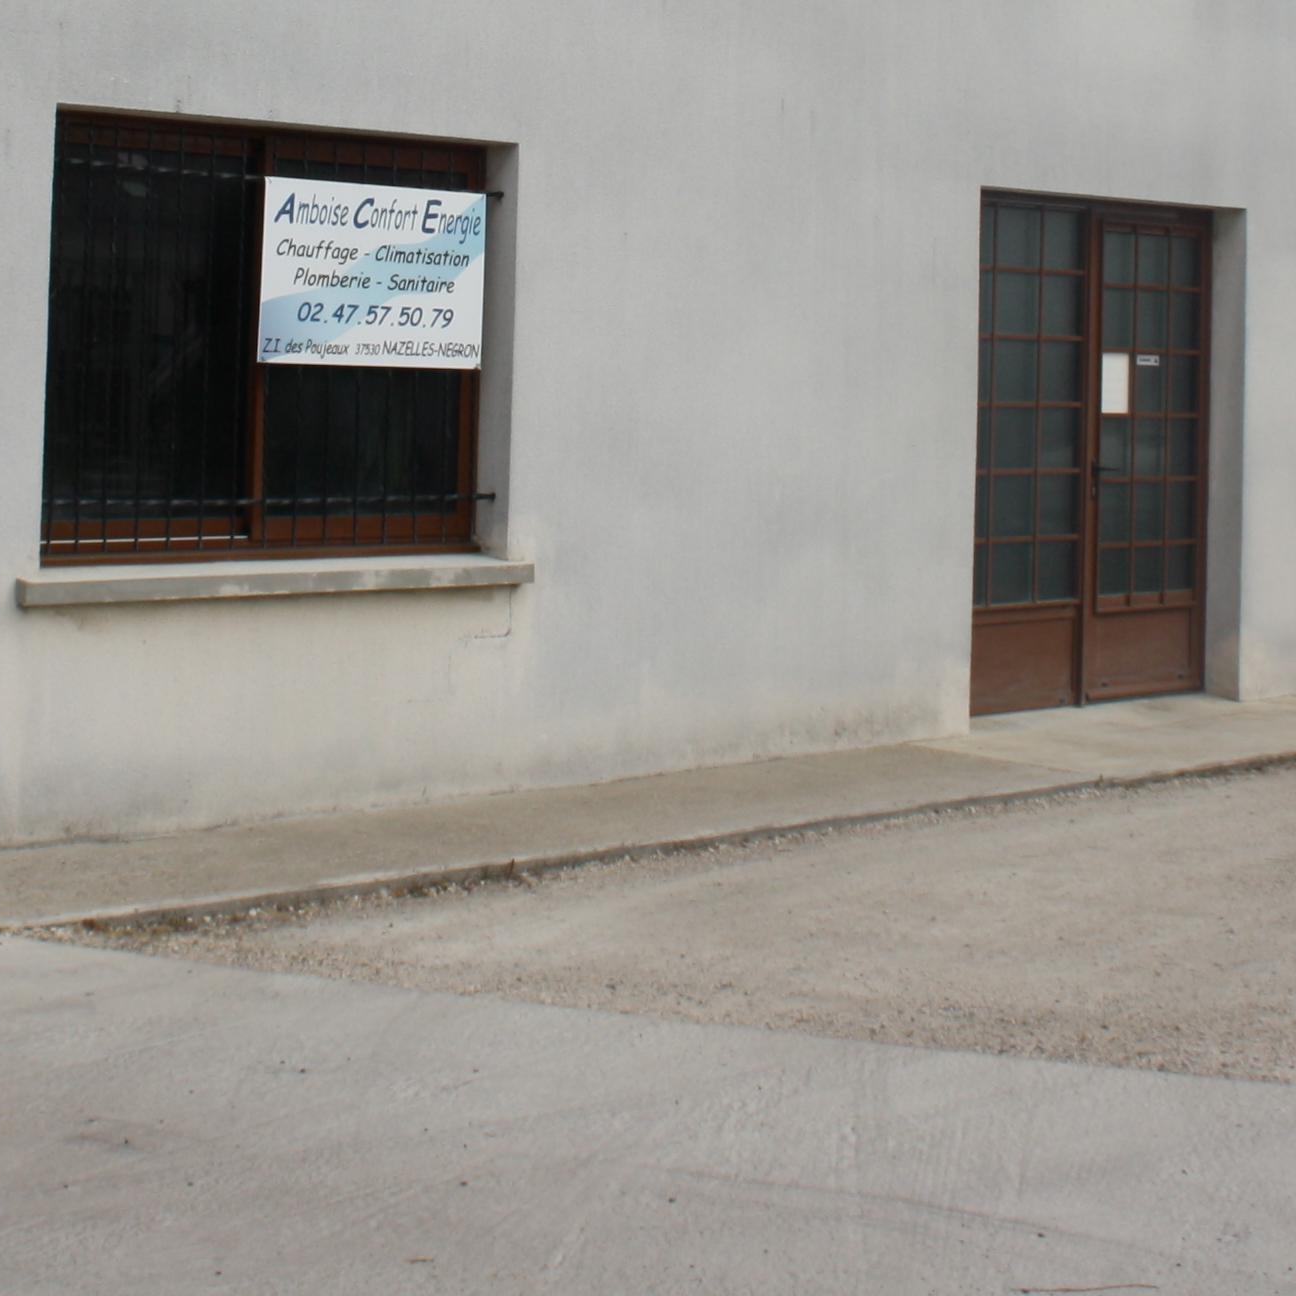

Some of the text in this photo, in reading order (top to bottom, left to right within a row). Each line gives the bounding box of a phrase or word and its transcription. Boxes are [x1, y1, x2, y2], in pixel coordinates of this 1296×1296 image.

[274, 192, 481, 244] Amboise Confort Energie
[276, 238, 358, 265] Chauffage
[375, 245, 469, 267] Climatisation
[293, 267, 371, 289] Plomberie
[387, 274, 455, 294] Sanitaire
[285, 339, 303, 354] des
[305, 339, 349, 359] Poujeaux
[355, 343, 381, 356] 37530
